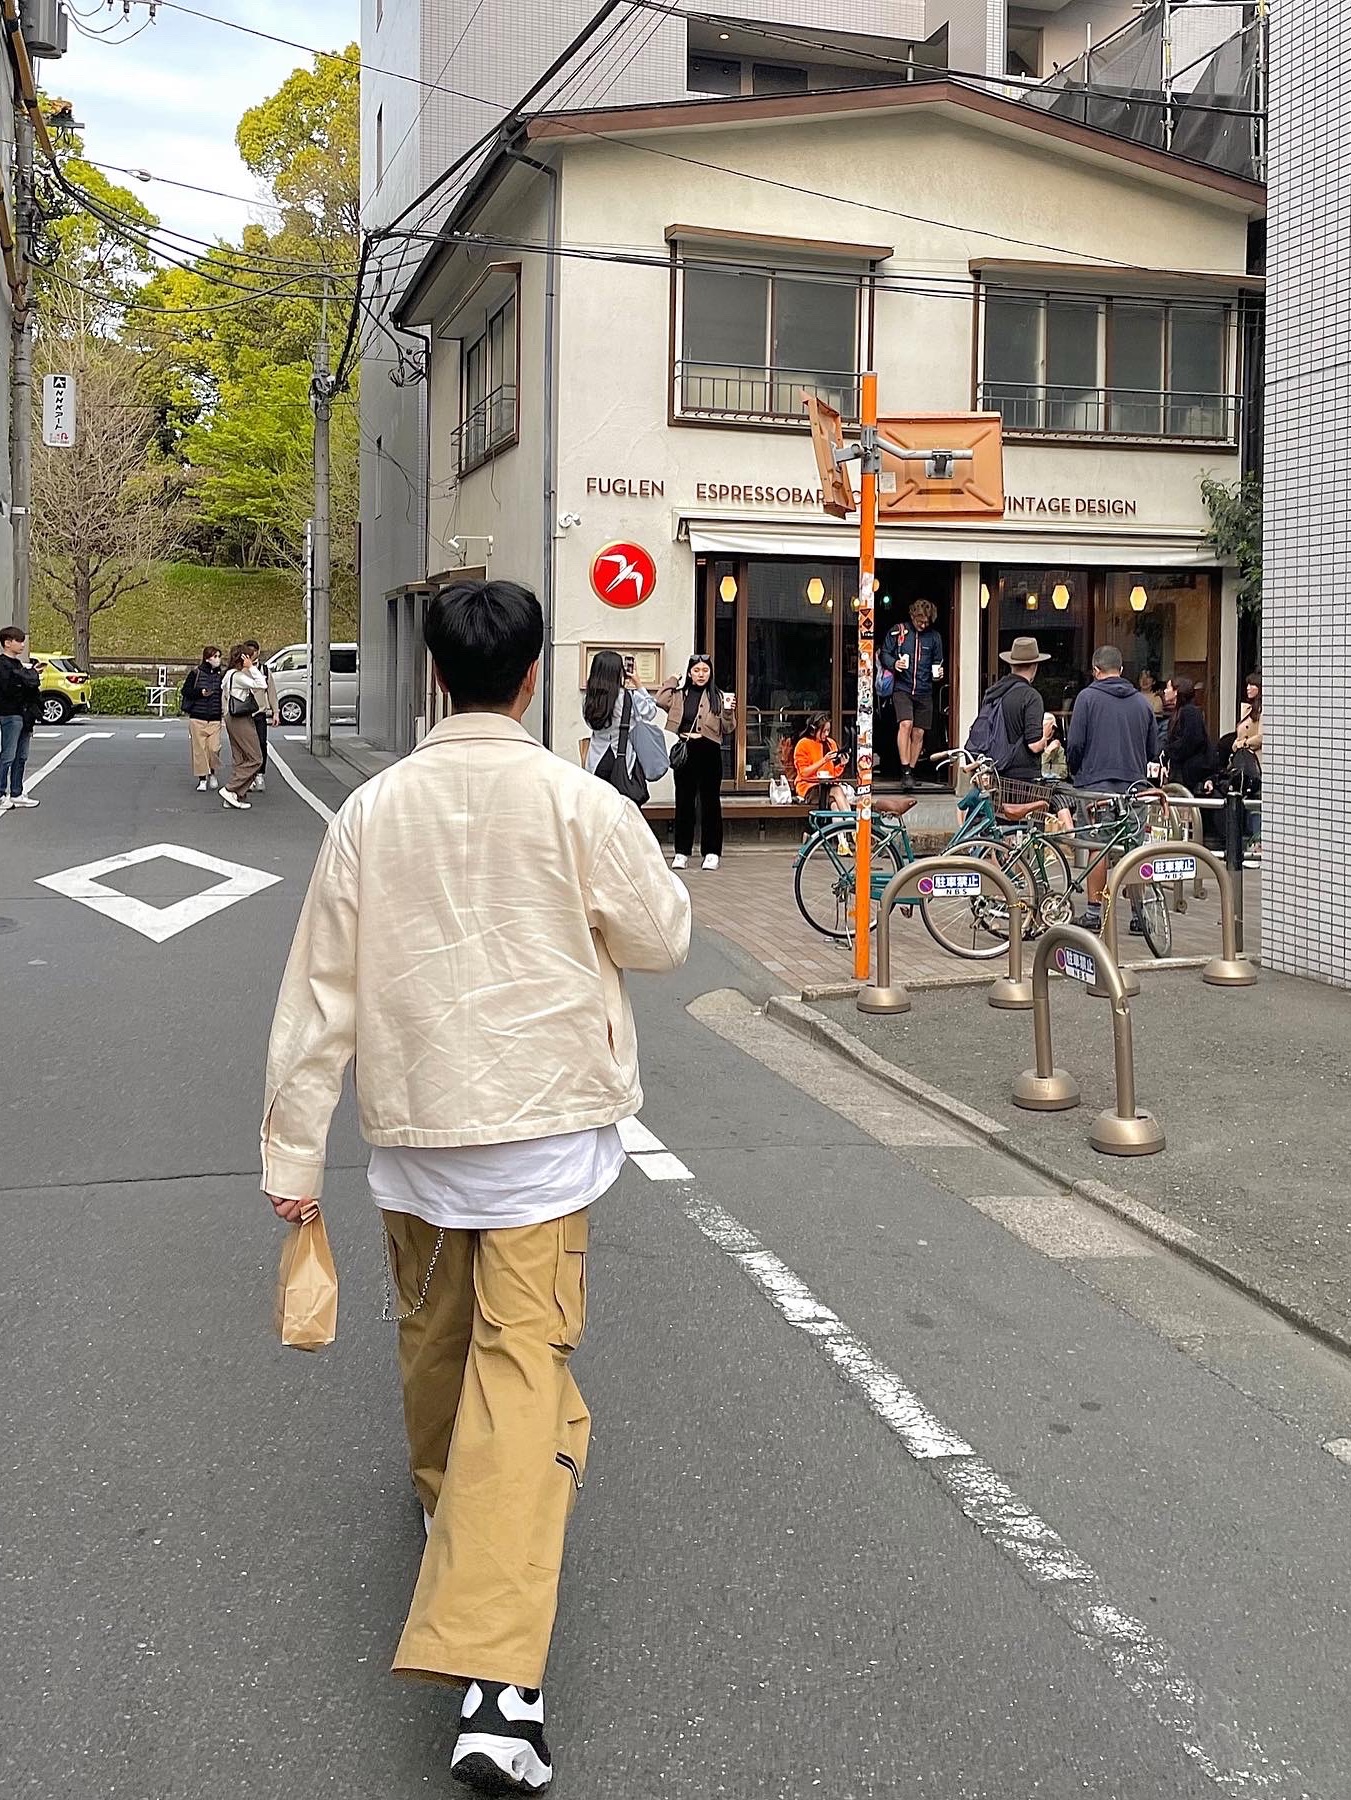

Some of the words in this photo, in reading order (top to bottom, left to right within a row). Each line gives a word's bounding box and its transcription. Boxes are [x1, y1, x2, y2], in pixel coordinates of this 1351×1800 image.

[586, 477, 664, 497] FUGLEN
[1075, 498, 1137, 515] DESIGN
[934, 873, 979, 888] 駐車禁止
